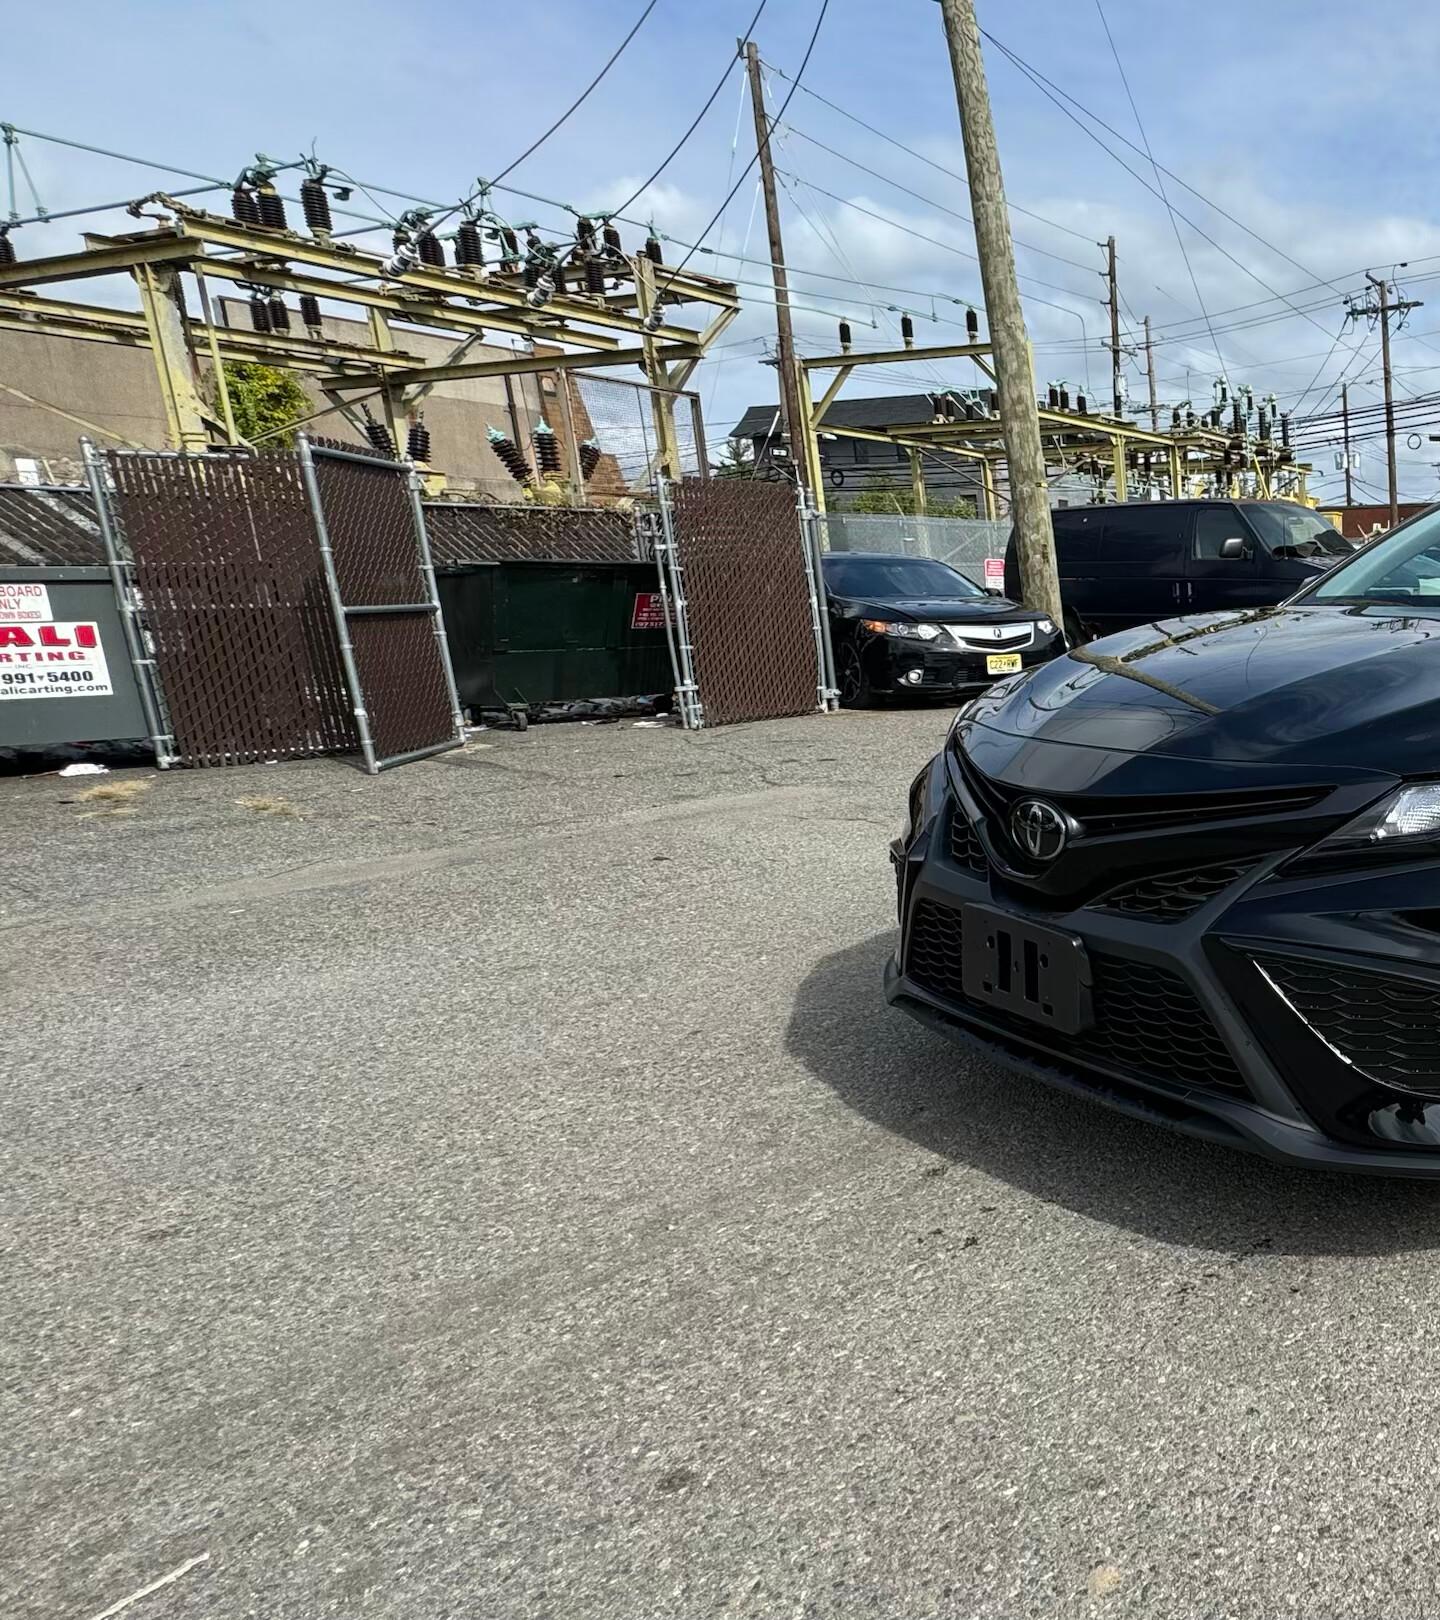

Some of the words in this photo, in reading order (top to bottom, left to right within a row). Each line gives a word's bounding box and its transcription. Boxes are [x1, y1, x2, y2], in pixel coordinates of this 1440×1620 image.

[0, 585, 43, 597] BOARD
[0, 625, 97, 648] ALI
[0, 684, 108, 695] alicarting.com
